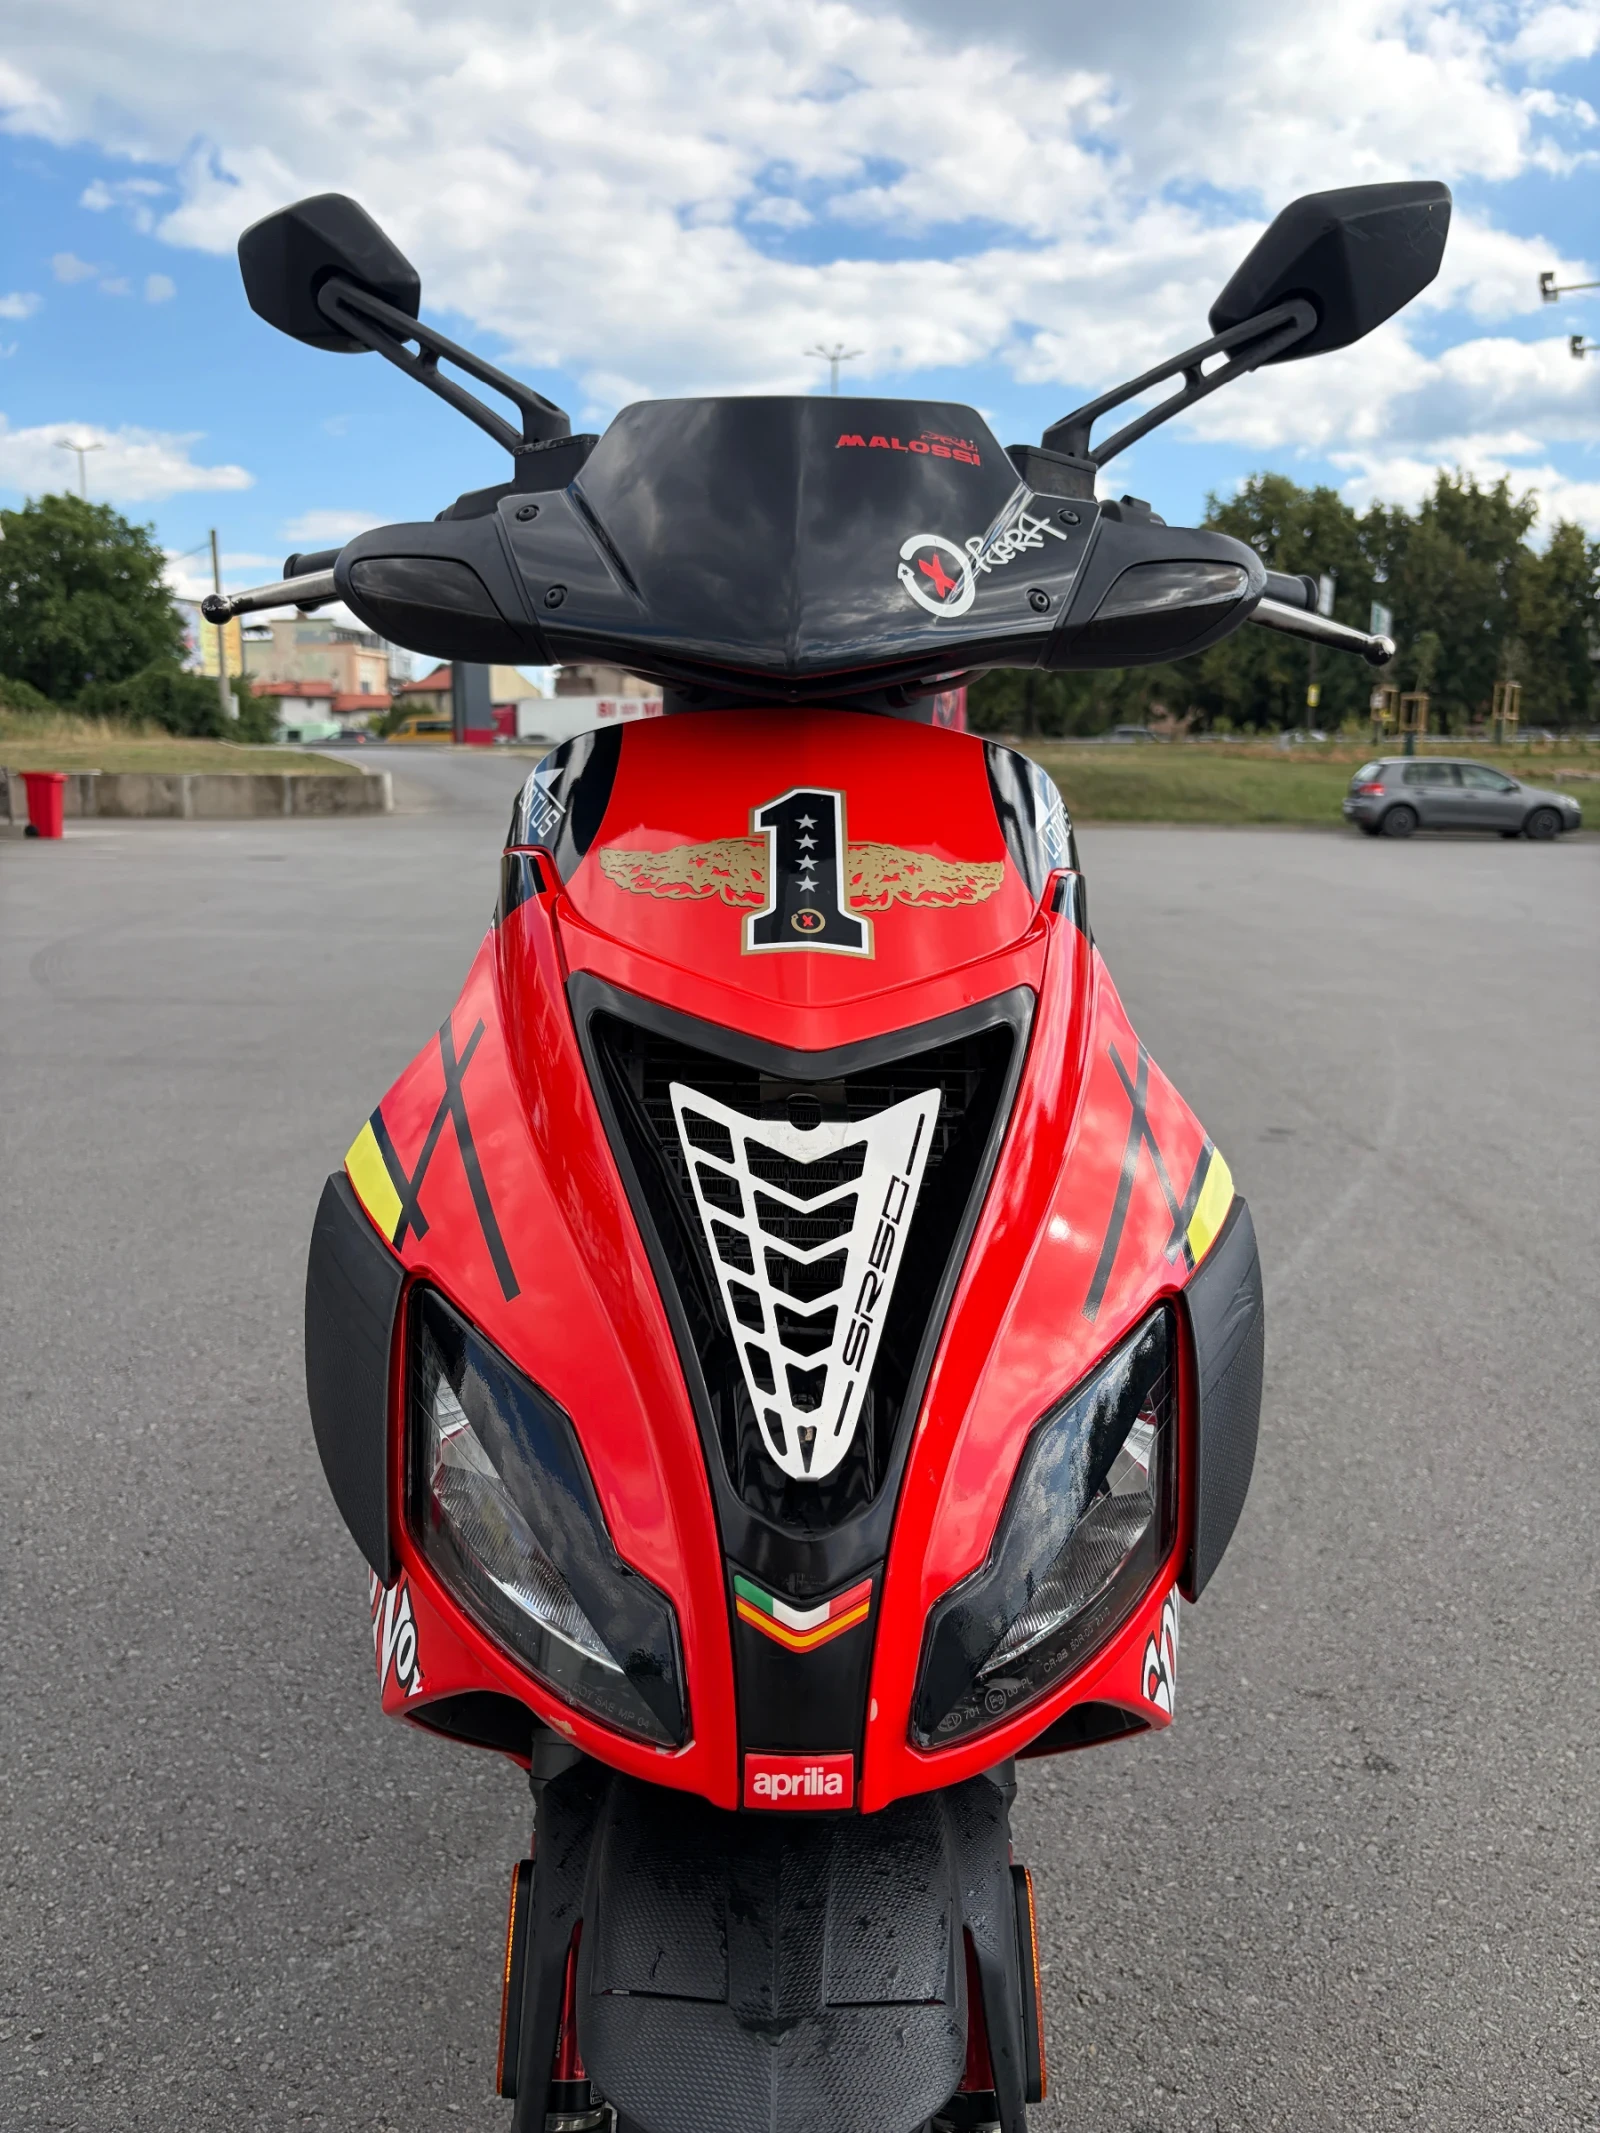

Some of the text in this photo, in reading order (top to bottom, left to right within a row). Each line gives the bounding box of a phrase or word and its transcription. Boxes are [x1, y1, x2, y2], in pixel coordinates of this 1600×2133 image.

[835, 434, 980, 467] MALOSSI
[741, 786, 875, 960] 1
[842, 1175, 910, 1373] SR50
[595, 1696, 615, 1712] SAE
[618, 1708, 635, 1720] MP
[637, 1717, 649, 1728] 04
[753, 1767, 843, 1801] aprilia
